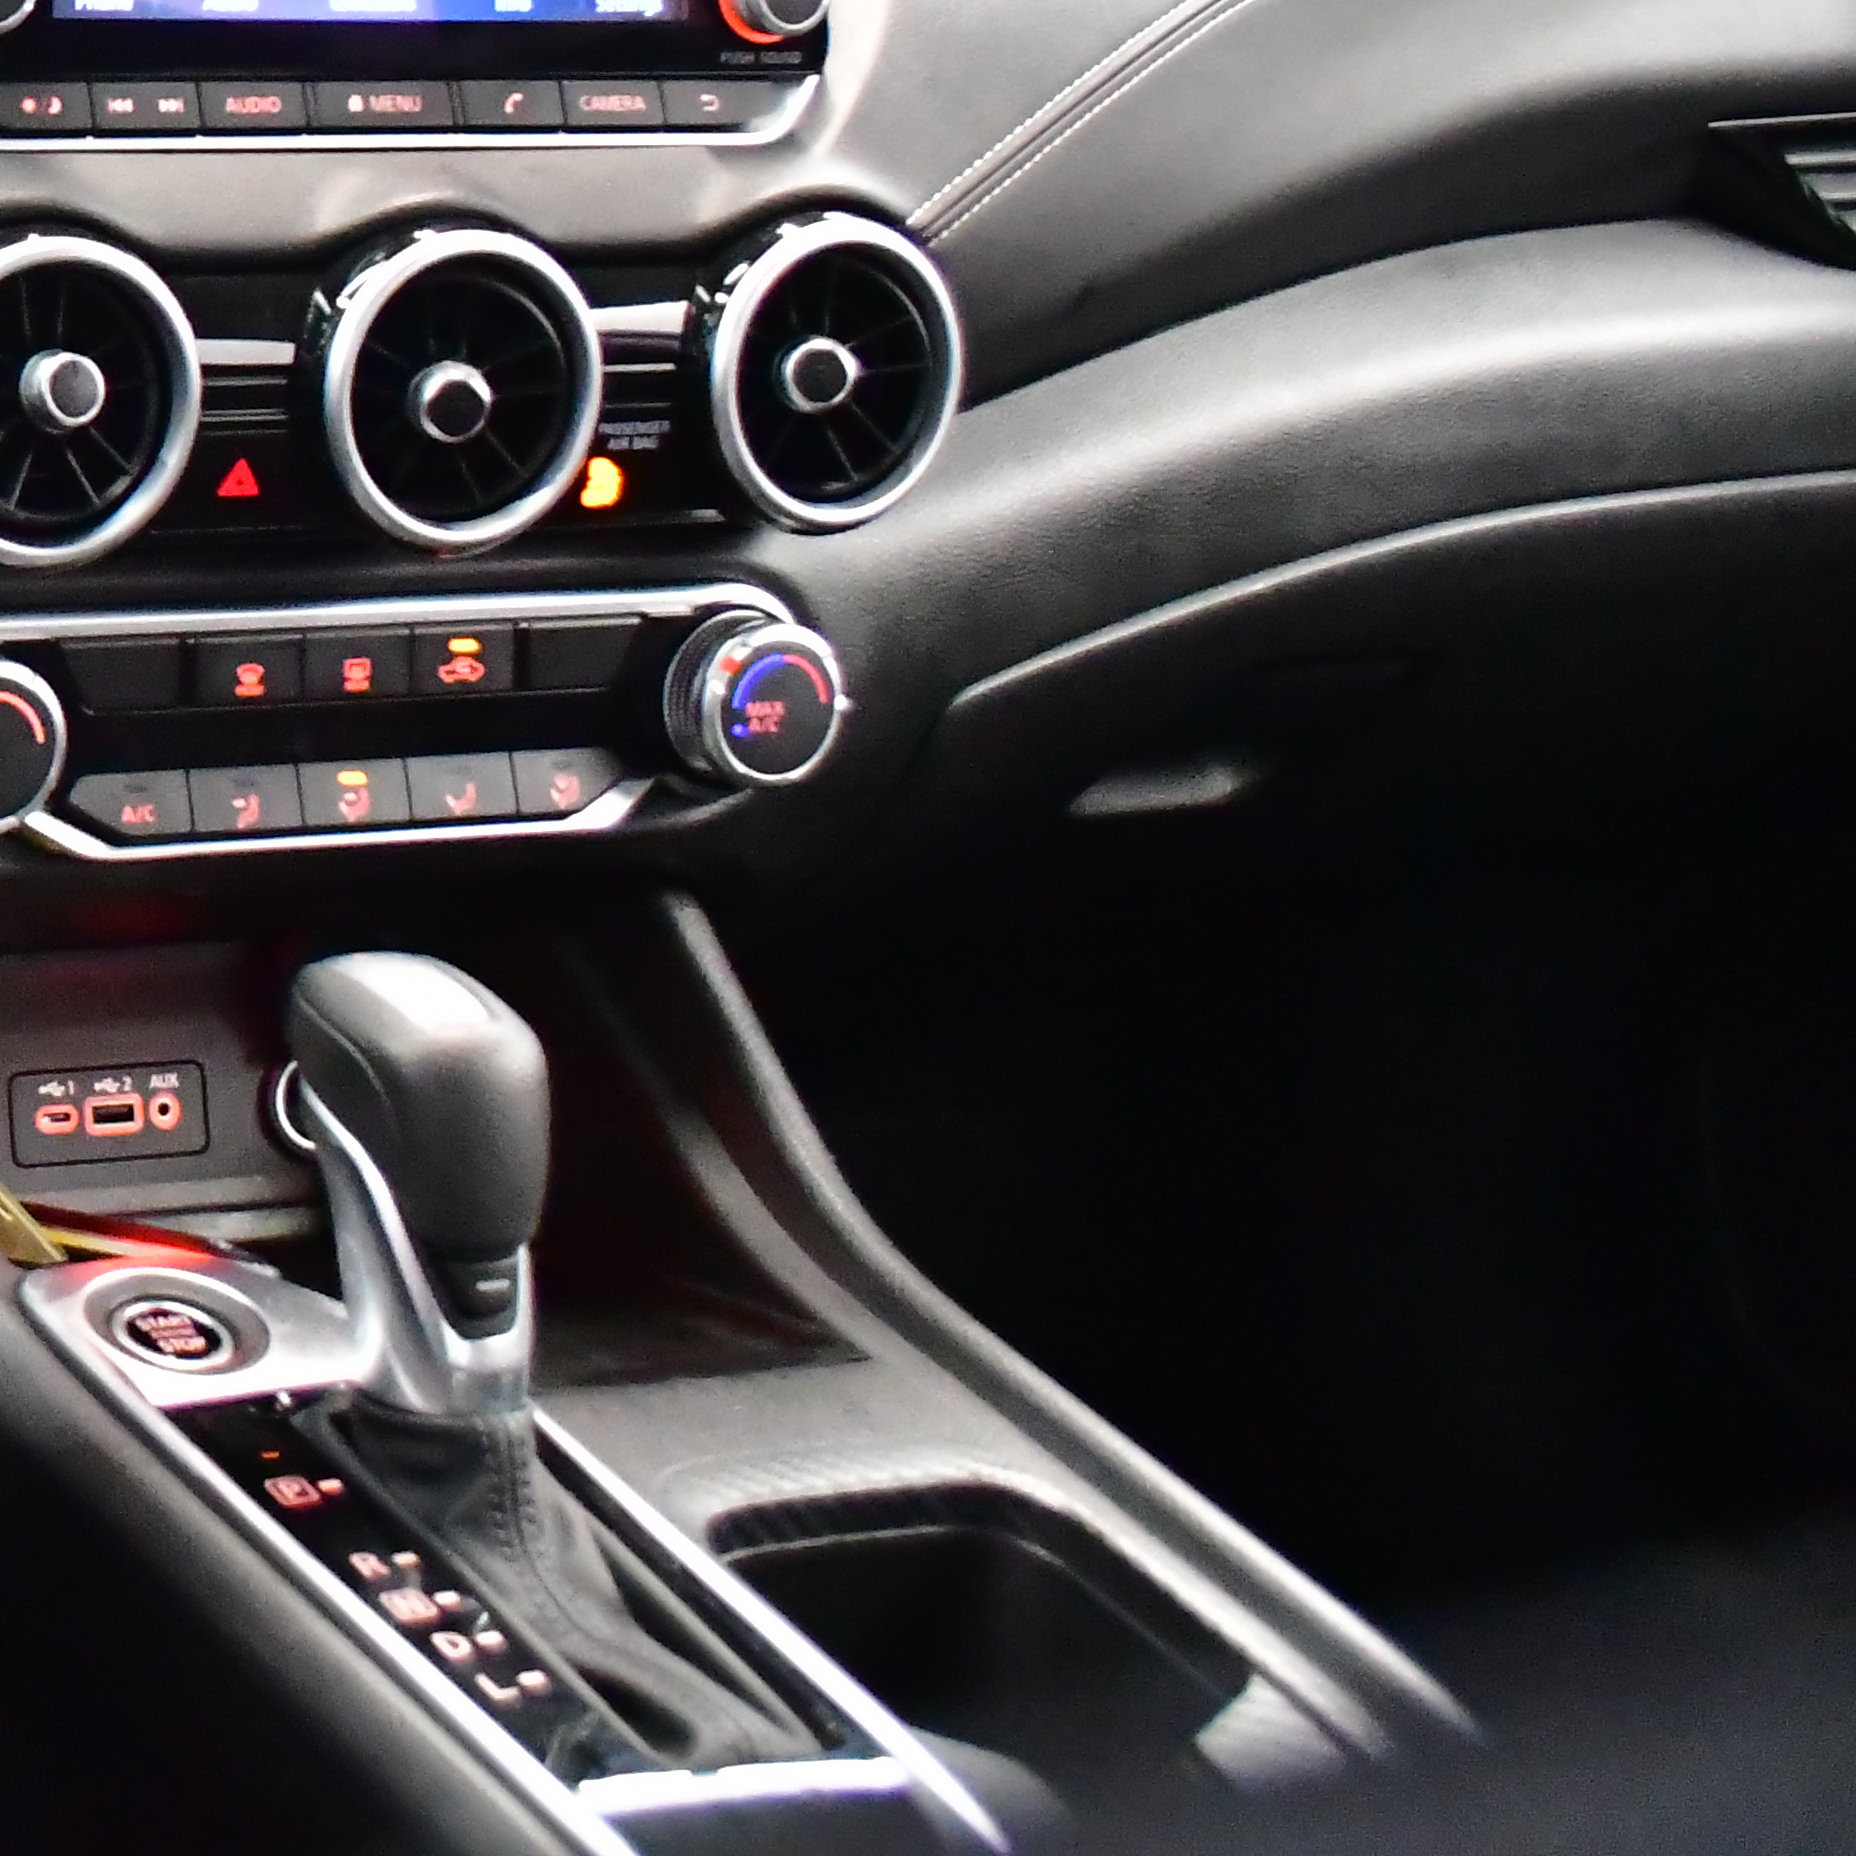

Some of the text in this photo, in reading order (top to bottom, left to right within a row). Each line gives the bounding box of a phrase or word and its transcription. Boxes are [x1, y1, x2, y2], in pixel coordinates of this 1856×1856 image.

[225, 95, 283, 114] AUDIO
[369, 94, 423, 113] MENU
[745, 701, 785, 717] MAX
[121, 804, 155, 824] A/C
[149, 1072, 179, 1088] AUX
[348, 1552, 390, 1580] R
[430, 1631, 475, 1663] D
[475, 1673, 521, 1704] L
